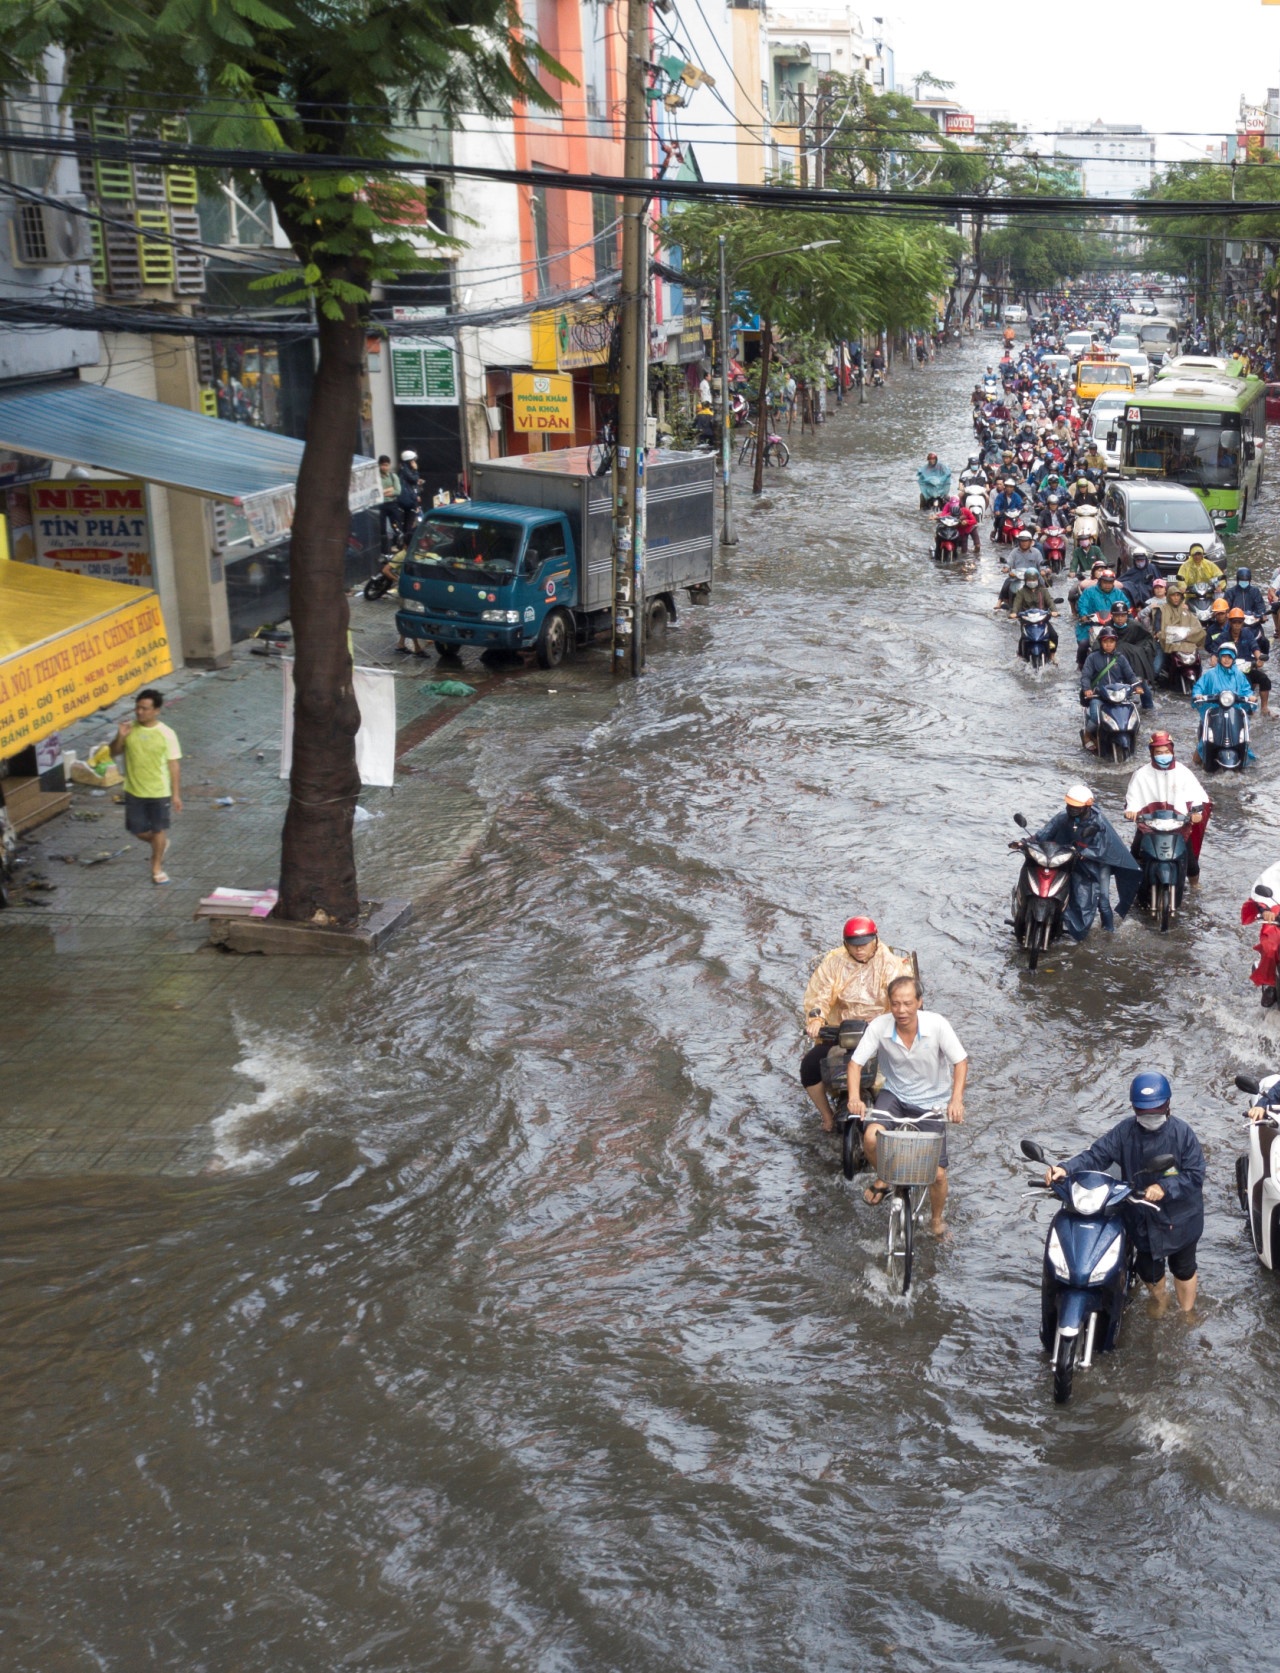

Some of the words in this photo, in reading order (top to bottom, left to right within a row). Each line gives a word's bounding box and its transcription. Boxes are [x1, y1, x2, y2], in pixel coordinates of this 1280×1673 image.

[948, 117, 973, 128] HOTEL
[518, 394, 544, 402] PHÒNG
[546, 394, 567, 402] KHÁM
[518, 414, 533, 428] VÌ
[537, 414, 569, 428] DÂN
[1129, 410, 1139, 419] 24
[36, 483, 143, 516] NỆM
[40, 515, 79, 536] TÍN
[86, 515, 145, 536] PHÁT
[11, 665, 33, 697] NỘI
[34, 649, 72, 684] THỊNH
[72, 632, 102, 666] PHÁT
[103, 619, 137, 650] CHÍNH
[136, 606, 160, 635] HIỆU
[0, 710, 15, 731] HẢ
[84, 667, 105, 685] NEM
[107, 655, 129, 674] CHUA
[33, 711, 53, 730] BAO
